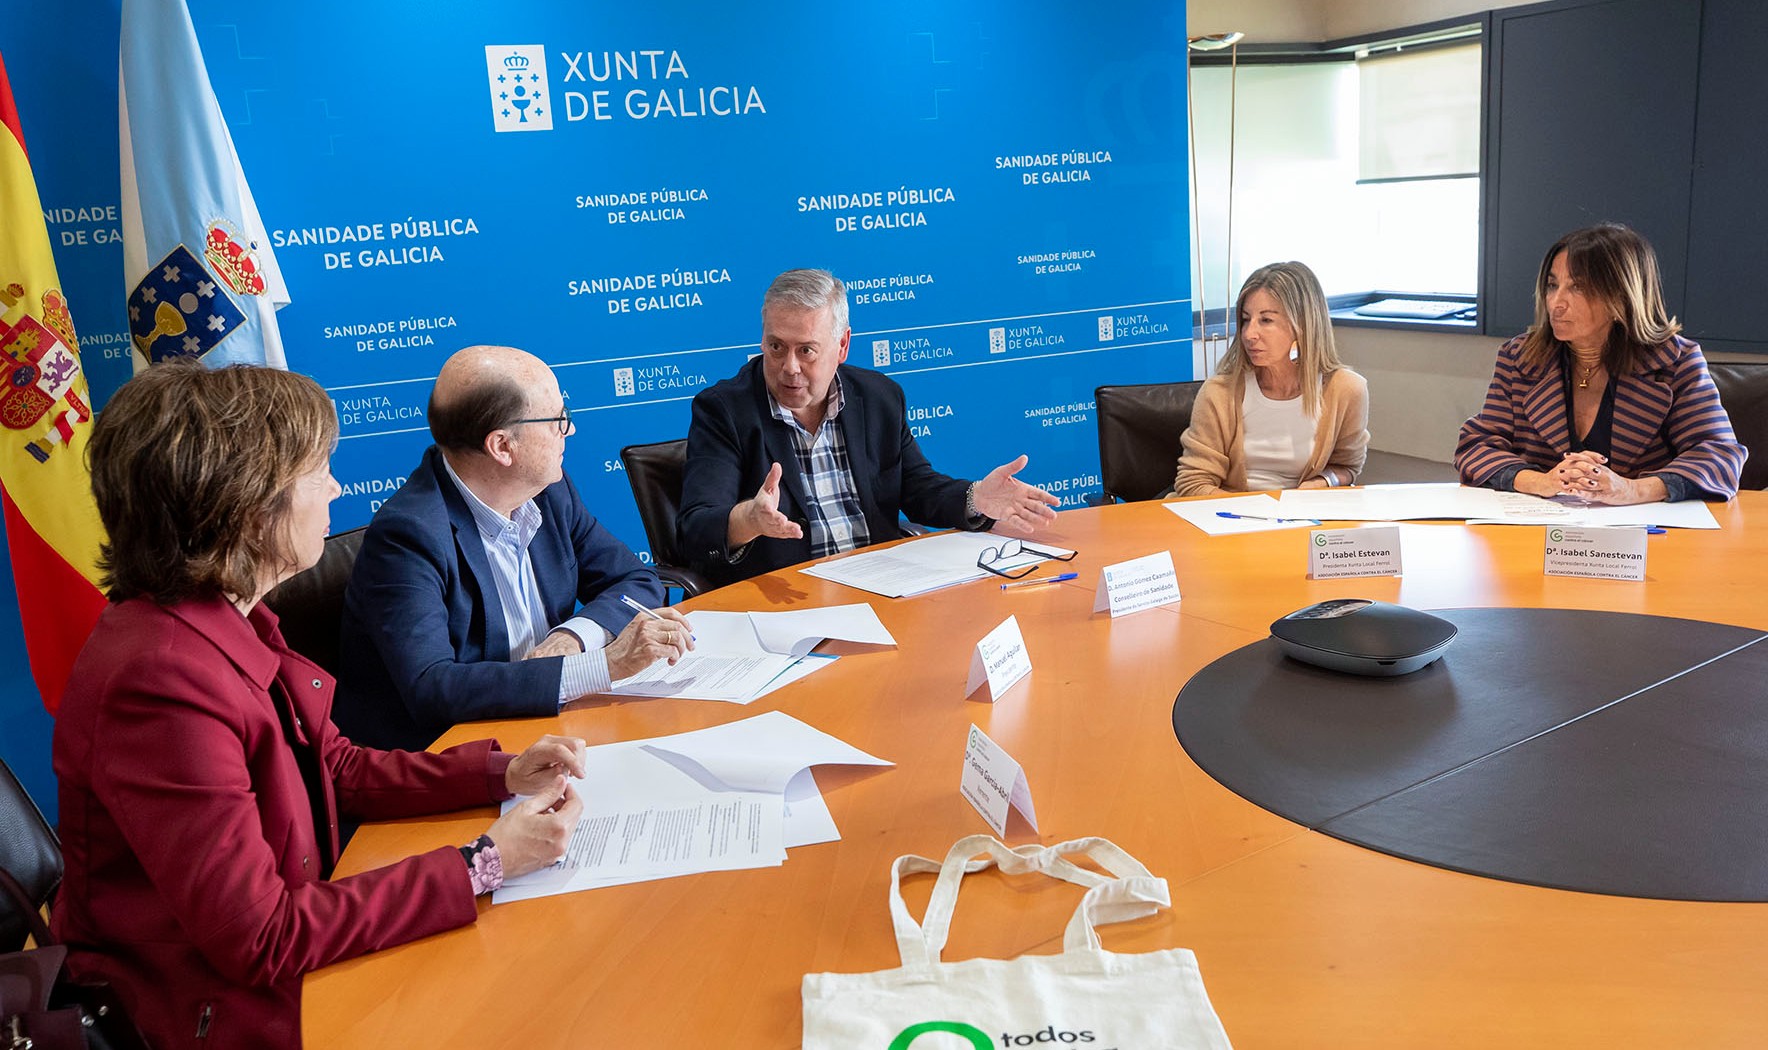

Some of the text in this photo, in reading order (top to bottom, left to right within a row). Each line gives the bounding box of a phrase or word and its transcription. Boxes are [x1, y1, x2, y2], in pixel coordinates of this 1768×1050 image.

[561, 50, 689, 82] XUNTA
[564, 86, 767, 122] DE GALICIA
[995, 149, 1112, 169] SANIDADE PÚBLICA
[1022, 169, 1091, 185] DE GALICIA
[576, 187, 709, 208] SANIDADE PÚBLICA
[797, 185, 955, 212] SANIDADE PÚBLICA
[43, 206, 118, 224] NIDADE
[608, 208, 686, 224] DE GALICIA
[835, 211, 927, 232] DE GALICIA
[61, 230, 88, 246] DE
[272, 217, 480, 248] SANIDADE PÚBLICA
[323, 246, 445, 270] DE GALICIA
[1017, 249, 1096, 265] SANIDADE PÚBLICA
[1035, 263, 1082, 275] DE GALICIA
[568, 268, 732, 296] SANIDADE PÚBLICA
[846, 273, 934, 291] NIDADE PÚBLICA
[608, 293, 703, 314] DE GALICIA
[856, 290, 915, 304] DE GALICIA
[324, 316, 457, 338] SANIDADE PÚBLICA
[1116, 315, 1149, 327] XUNTA
[1008, 326, 1044, 338] XUNTA
[1116, 323, 1169, 337] DE GALICIA
[81, 332, 131, 346] ANIDAD
[356, 335, 434, 352] DE GALICIA
[893, 338, 931, 351] XUNTA
[1008, 335, 1065, 350] DE GALICIA
[104, 348, 121, 359] DE
[893, 346, 954, 363] DE GALICIA
[638, 365, 680, 379] XUNTA
[638, 374, 707, 392] DE GALICIA
[342, 397, 391, 412] XUNTA
[1024, 401, 1097, 418] SANIDADE PÚBLIC
[343, 406, 423, 425] DE GALICIA
[907, 405, 954, 421] ÚBLICA
[1042, 414, 1087, 427] DE GALICIA
[342, 476, 407, 497] ANIDAD
[1072, 474, 1101, 489] PÚBL
[1332, 550, 1357, 559] Isabel
[1358, 549, 1391, 558] Estevan
[1560, 549, 1588, 558] Isabel
[1590, 550, 1643, 561] Sanestevan
[1114, 580, 1134, 589] Antonio
[1150, 583, 1174, 593] Sanidade
[1001, 1025, 1096, 1048] todos
